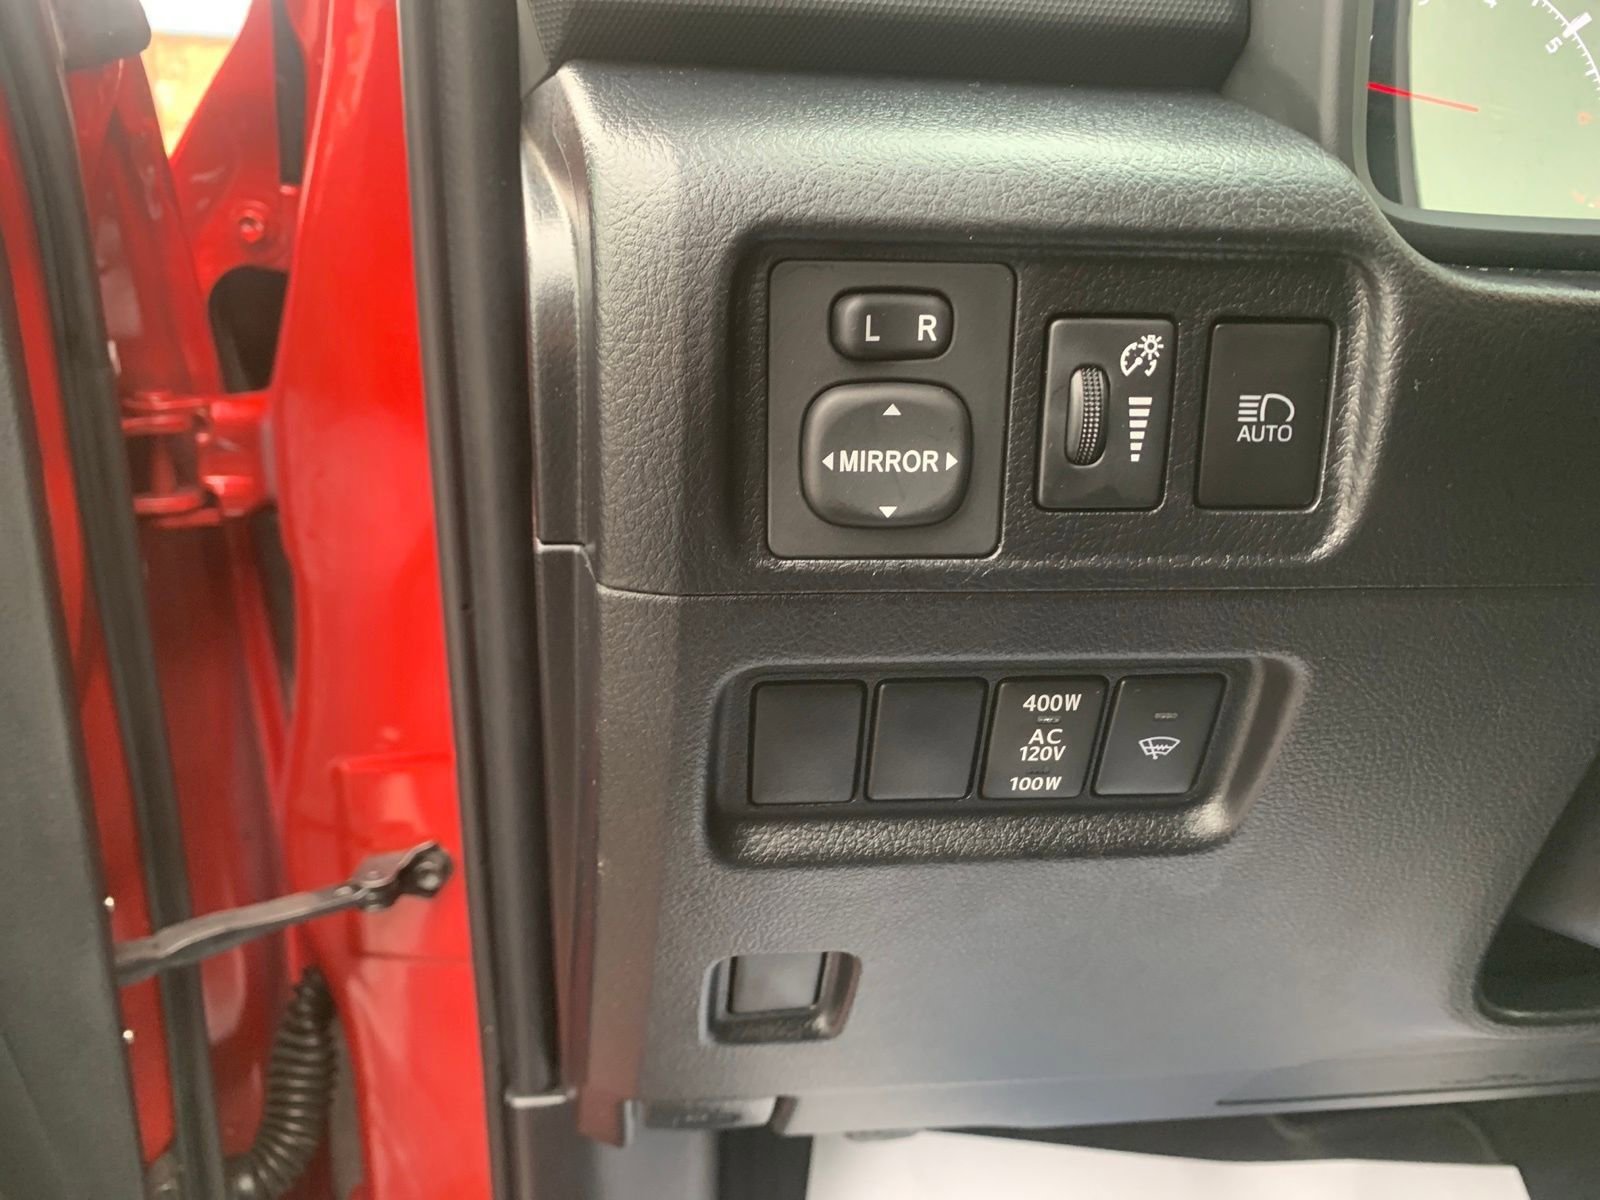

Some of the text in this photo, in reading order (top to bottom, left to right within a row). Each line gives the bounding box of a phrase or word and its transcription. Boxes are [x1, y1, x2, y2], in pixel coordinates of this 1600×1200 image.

[1545, 37, 1563, 54] 5
[865, 314, 937, 341] L R
[1236, 425, 1293, 442] AUTO
[839, 450, 939, 472] MIRROR
[1022, 694, 1082, 711] 400W
[1028, 728, 1063, 744] AC
[1019, 746, 1066, 761] 120V
[1009, 776, 1062, 791] 100W
